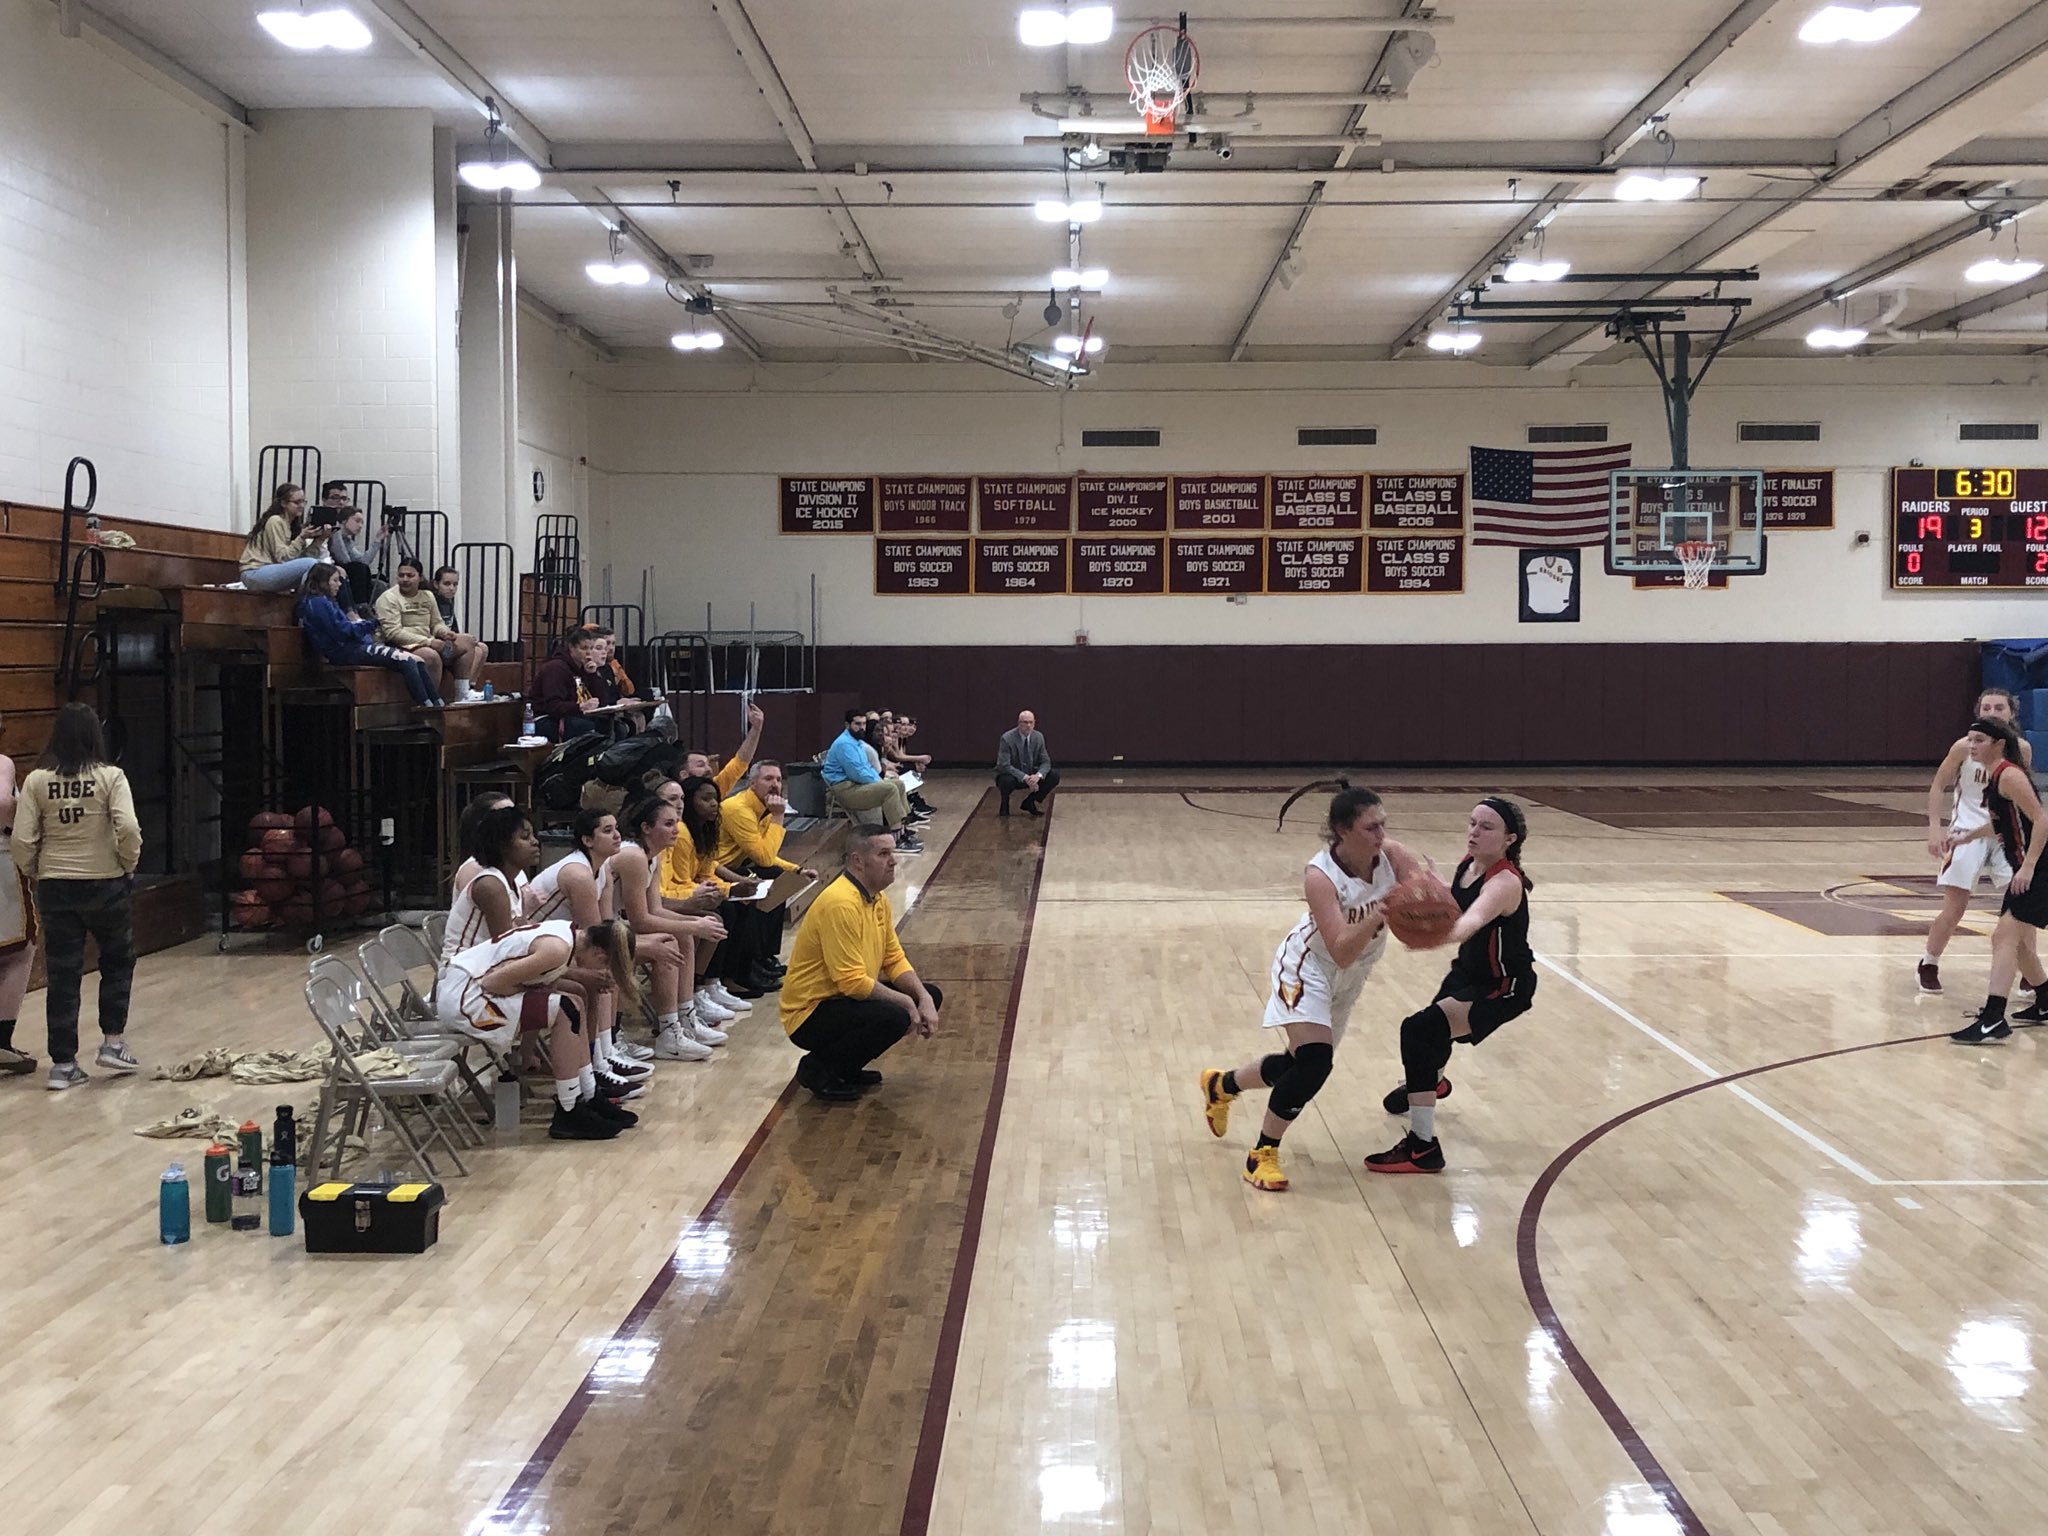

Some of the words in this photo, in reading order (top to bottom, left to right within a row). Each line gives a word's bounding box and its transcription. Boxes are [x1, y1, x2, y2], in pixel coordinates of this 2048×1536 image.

[790, 481, 817, 493] STATE
[821, 481, 866, 492] CHAMPIONS
[885, 484, 914, 495] STATE
[917, 483, 966, 495] CHAMPIONS
[984, 483, 1012, 495] STATE
[1016, 483, 1066, 495] CHAMPIONS
[1079, 482, 1105, 492] STATE
[1108, 482, 1166, 492] CHAMPIONSHIP
[1181, 484, 1207, 494] STATE
[1211, 483, 1257, 494] CHAMPIONS
[1277, 480, 1305, 490] STATE
[1309, 479, 1356, 490] CHAMPIONS
[1376, 479, 1404, 489] STATE
[1409, 478, 1457, 489] CHAMPIONS
[1750, 479, 1777, 490] SATE
[1782, 479, 1822, 490] FINALIST
[1956, 471, 2012, 496] 6:30
[799, 494, 842, 505] DIVISION
[847, 494, 857, 505] II
[1129, 495, 1138, 504] II
[1283, 491, 1336, 503] CLASS
[1339, 491, 1350, 502] S
[1382, 491, 1437, 502] CLASS
[1440, 491, 1452, 502] S
[1782, 496, 1816, 506] SOCCER
[884, 500, 905, 512] BOYS
[908, 500, 936, 511] INDOOR
[940, 500, 966, 511] TRACK
[994, 499, 1056, 511] SOFTBALL
[1179, 500, 1201, 510] BOYS
[1205, 499, 1259, 510] BASKETBALL
[1374, 504, 1458, 515] BASEBALL
[1902, 501, 1950, 512] RAIDERS
[2010, 501, 2048, 512] GUEST
[796, 508, 811, 518] ICE
[816, 507, 859, 518] HOCKEY
[1091, 507, 1108, 516] ICE
[1112, 507, 1153, 516] HOCKEY
[1275, 505, 1357, 516] BASEBALL
[1961, 508, 1989, 516] PERIOD
[1109, 519, 1137, 527] 2000
[1202, 515, 1235, 523] 2001
[1298, 518, 1334, 527] 2005
[812, 520, 844, 530] 2015
[1918, 516, 1942, 539] 19
[1970, 519, 1982, 538] 3
[885, 546, 912, 557] STATE
[916, 545, 962, 556] CHAMPIONS
[983, 546, 1009, 557] STATE
[1013, 545, 1059, 556] CHAMPIONS
[1080, 546, 1106, 557] STATE
[1110, 545, 1156, 556] CHAMPIONS
[1177, 545, 1203, 556] STATE
[1208, 545, 1255, 555] CHAMPIONS
[1276, 542, 1303, 552] STATE
[1307, 541, 1354, 552] CHAMPIONS
[1376, 541, 1404, 551] STATE
[1407, 540, 1456, 551] CHAMPIONS
[1899, 544, 1923, 552] FOULS
[1948, 544, 1977, 552] PLAYER
[1983, 544, 2002, 552] FOUL
[1281, 554, 1334, 565] CLASS
[1338, 554, 1349, 565] S
[1381, 553, 1435, 565] CLASS
[1438, 553, 1450, 564] S
[1908, 553, 1920, 573] 0
[894, 562, 916, 573] BOYS
[920, 562, 953, 572] SOCCER
[992, 562, 1014, 573] BOYS
[1017, 561, 1050, 573] SOCCER
[1089, 562, 1111, 573] BOYS
[1114, 561, 1146, 573] SOCCER
[1187, 562, 1208, 572] BOYS
[1212, 561, 1245, 572] SOCCER
[1385, 567, 1408, 577] BOYS
[1411, 566, 1445, 577] SOCCER
[1285, 567, 1308, 578] BOYS
[1311, 567, 1345, 578] SOCCER
[1202, 577, 1230, 586] 1971
[1898, 577, 1923, 585] SCORE
[1961, 577, 1988, 585] MATCH
[48, 781, 96, 799] RISE
[59, 808, 84, 824] UP
[216, 1164, 230, 1182] G
